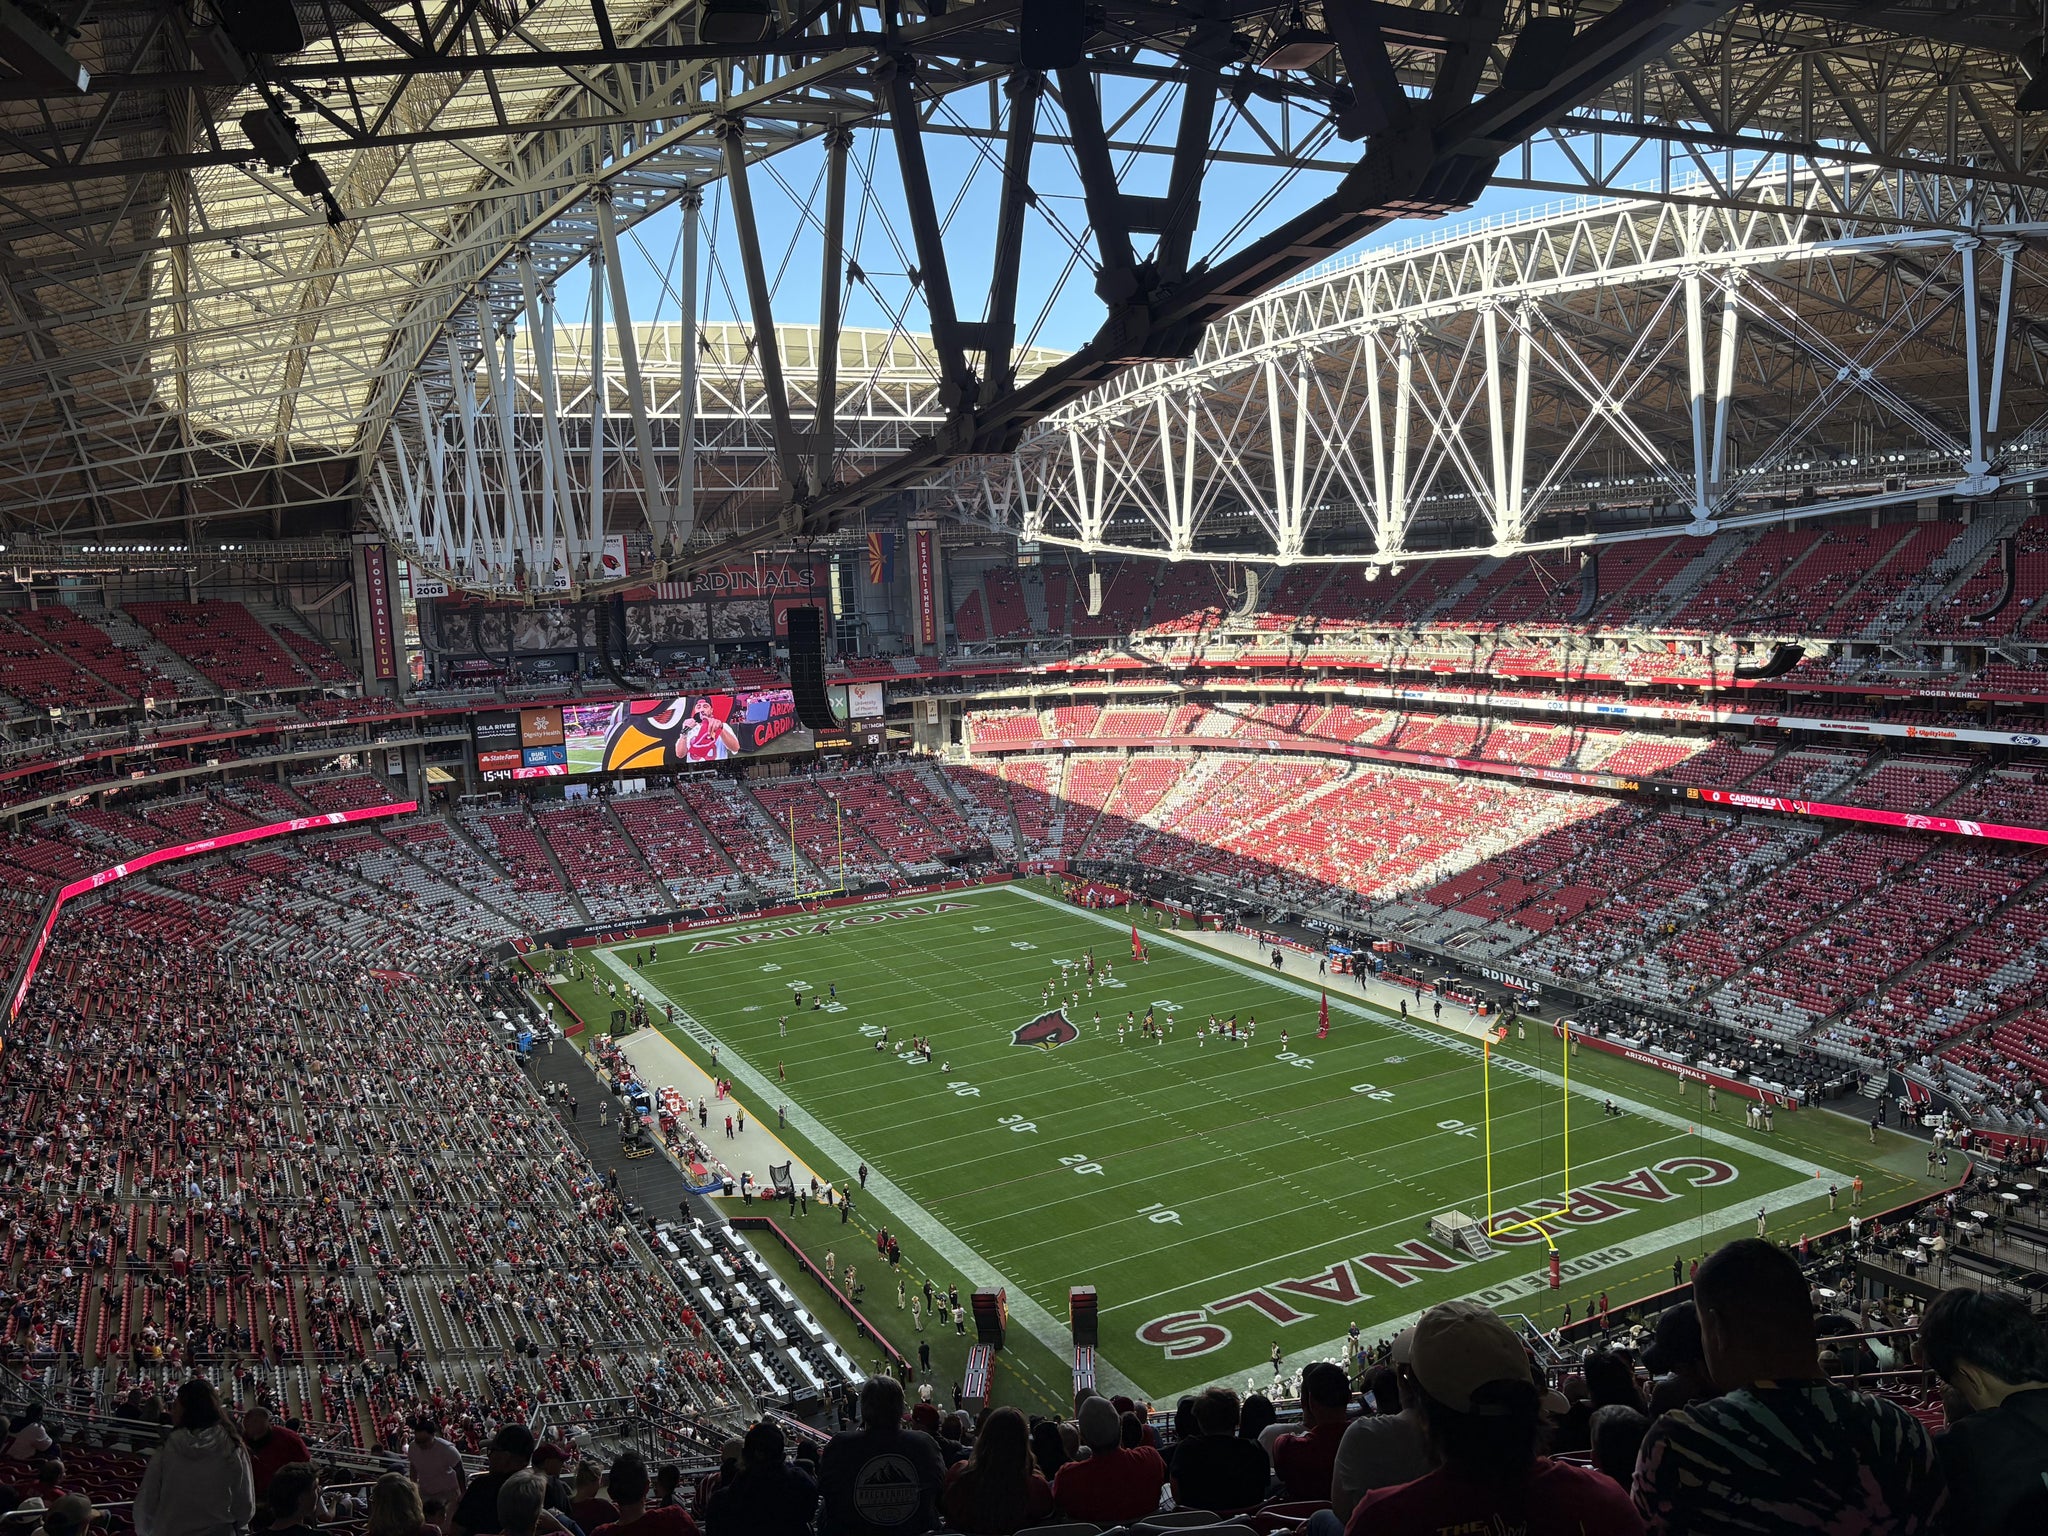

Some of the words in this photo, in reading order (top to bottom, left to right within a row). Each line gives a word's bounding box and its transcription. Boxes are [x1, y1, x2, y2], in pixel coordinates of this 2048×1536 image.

[690, 569, 816, 592] RDINALS
[921, 541, 930, 614] ESTABLISHED
[416, 587, 444, 595] 2008
[372, 558, 386, 635] FOOTBALL
[379, 638, 390, 675] CLUB
[828, 697, 844, 707] OX
[1948, 691, 1981, 699] WEHRLI
[1547, 702, 1563, 710] COX
[1672, 711, 1691, 720] State
[1692, 712, 1711, 722] Farm
[283, 723, 316, 731] MARSHALL
[523, 731, 543, 739] Dignity
[543, 729, 561, 737] Health
[1919, 729, 1938, 738] Dignity
[483, 770, 511, 782] 15:44
[1543, 770, 1572, 781] FALCONS
[1616, 780, 1639, 791] 15:44
[1712, 792, 1720, 800] 0
[1729, 794, 1776, 806] CARDINALS
[863, 893, 888, 901] ARIZON
[898, 887, 928, 895] ARDINALS
[584, 924, 612, 932] ARIZONA
[613, 919, 647, 928] CARDINALS
[688, 918, 720, 928] ARIZONA
[723, 912, 762, 923] CARINALS
[688, 902, 980, 954] ARIZONA
[785, 979, 813, 992] 20
[1482, 967, 1540, 991] RDINALS
[819, 1001, 848, 1013] 30
[1151, 999, 1183, 1012] 50
[680, 1021, 718, 1044] CHANGE
[858, 1024, 884, 1037] 40
[1383, 1019, 1458, 1046] INSPIRE
[1275, 1052, 1315, 1068] 30
[1625, 1051, 1660, 1066] ARIZONA
[1662, 1062, 1707, 1081] CARDINALS
[946, 1081, 979, 1096] 40
[1350, 1083, 1396, 1101] 20
[997, 1114, 1036, 1132] 30
[1437, 1119, 1477, 1137] 10
[1058, 1153, 1102, 1175] 20
[1137, 1202, 1181, 1225] 10
[1136, 1157, 1740, 1360] CARDNALS
[1463, 1284, 1523, 1306] LOV
[1436, 1520, 1484, 1536] THE
